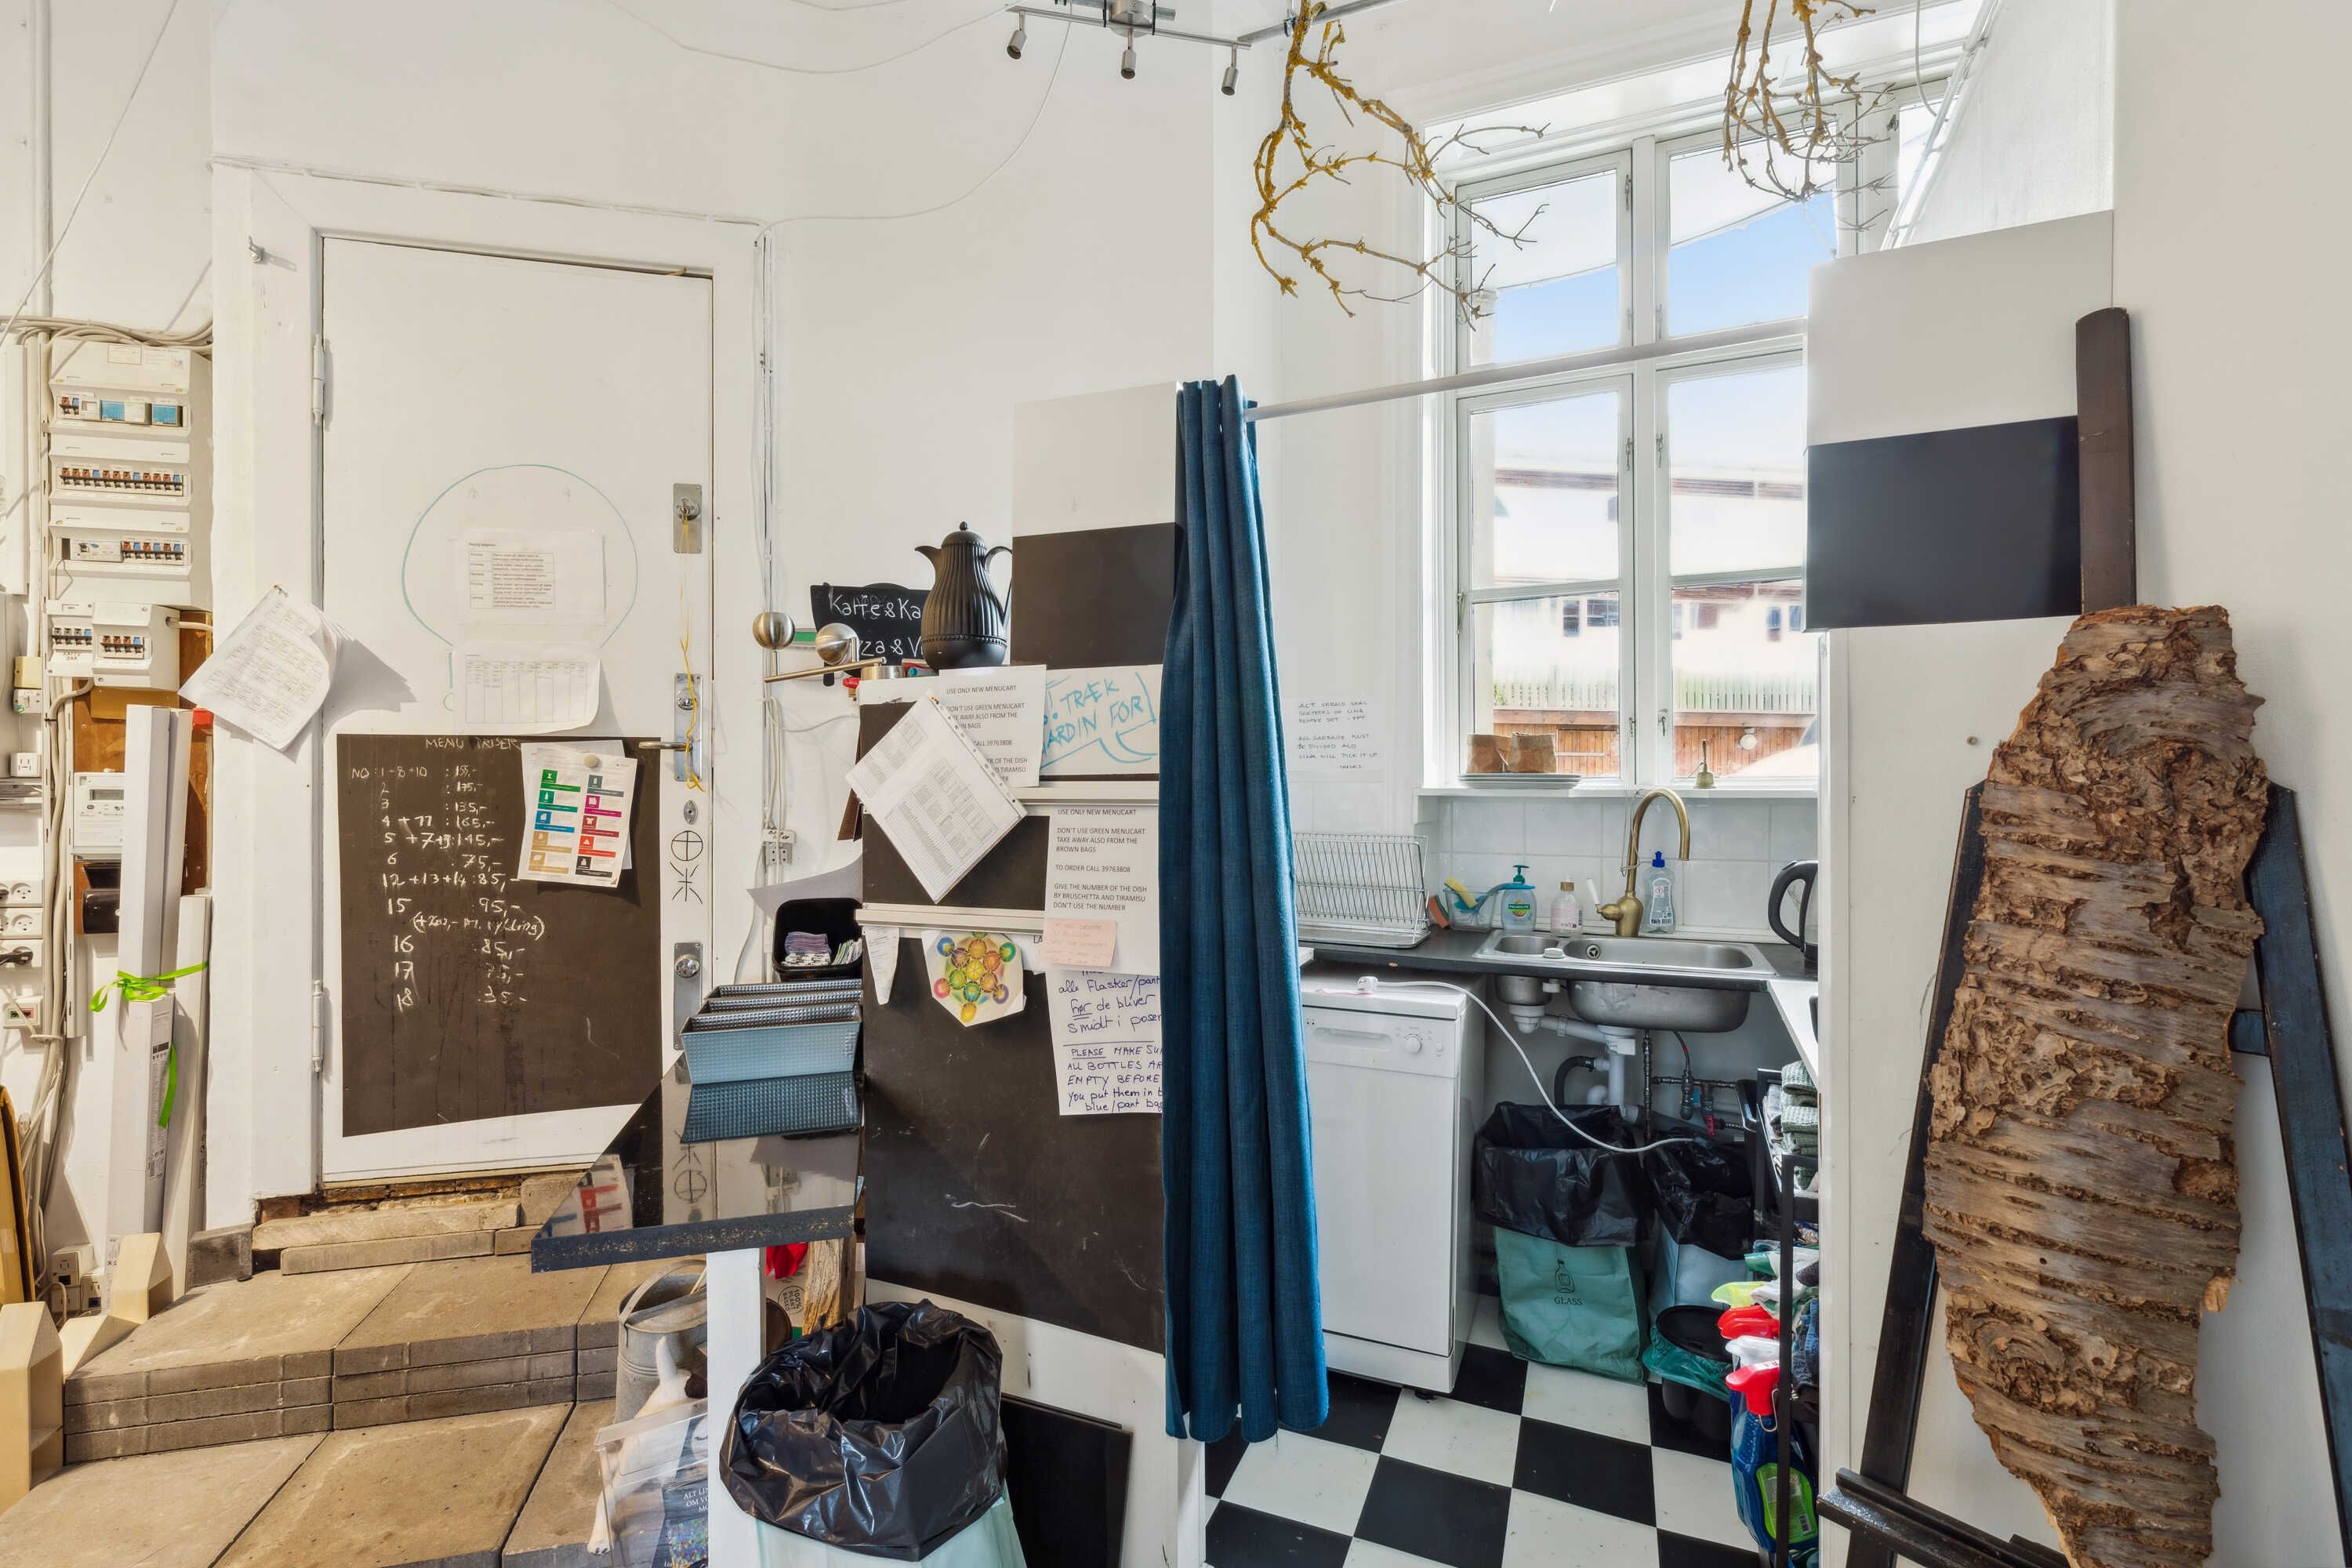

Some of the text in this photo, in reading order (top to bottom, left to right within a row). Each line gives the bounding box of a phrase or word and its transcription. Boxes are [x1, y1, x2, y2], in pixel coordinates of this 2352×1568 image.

[829, 594, 881, 618] Kaffe
[884, 602, 895, 618] &
[890, 638, 903, 655] &
[1109, 695, 1144, 728] FOR
[426, 738, 464, 749] MENU
[381, 799, 390, 809] 3
[382, 815, 390, 827] 4
[384, 833, 396, 844] 5
[387, 851, 398, 865] 6
[388, 898, 412, 914] 15
[394, 935, 415, 953] 16
[395, 961, 413, 980] 17
[397, 988, 413, 1012] 18
[1097, 997, 1110, 1011] de
[1117, 994, 1156, 1007] bliver
[1071, 1047, 1105, 1058] PLEASE
[1114, 1047, 1142, 1055] MAKE
[1067, 1062, 1082, 1071] ALL
[1087, 1062, 1142, 1071] BOTTLES
[1068, 1074, 1160, 1091] EMPTY BEFORE
[1091, 1091, 1109, 1103] put
[1113, 1087, 1140, 1097] them
[1143, 1087, 1152, 1097] in
[1554, 1297, 1582, 1305] GLASS
